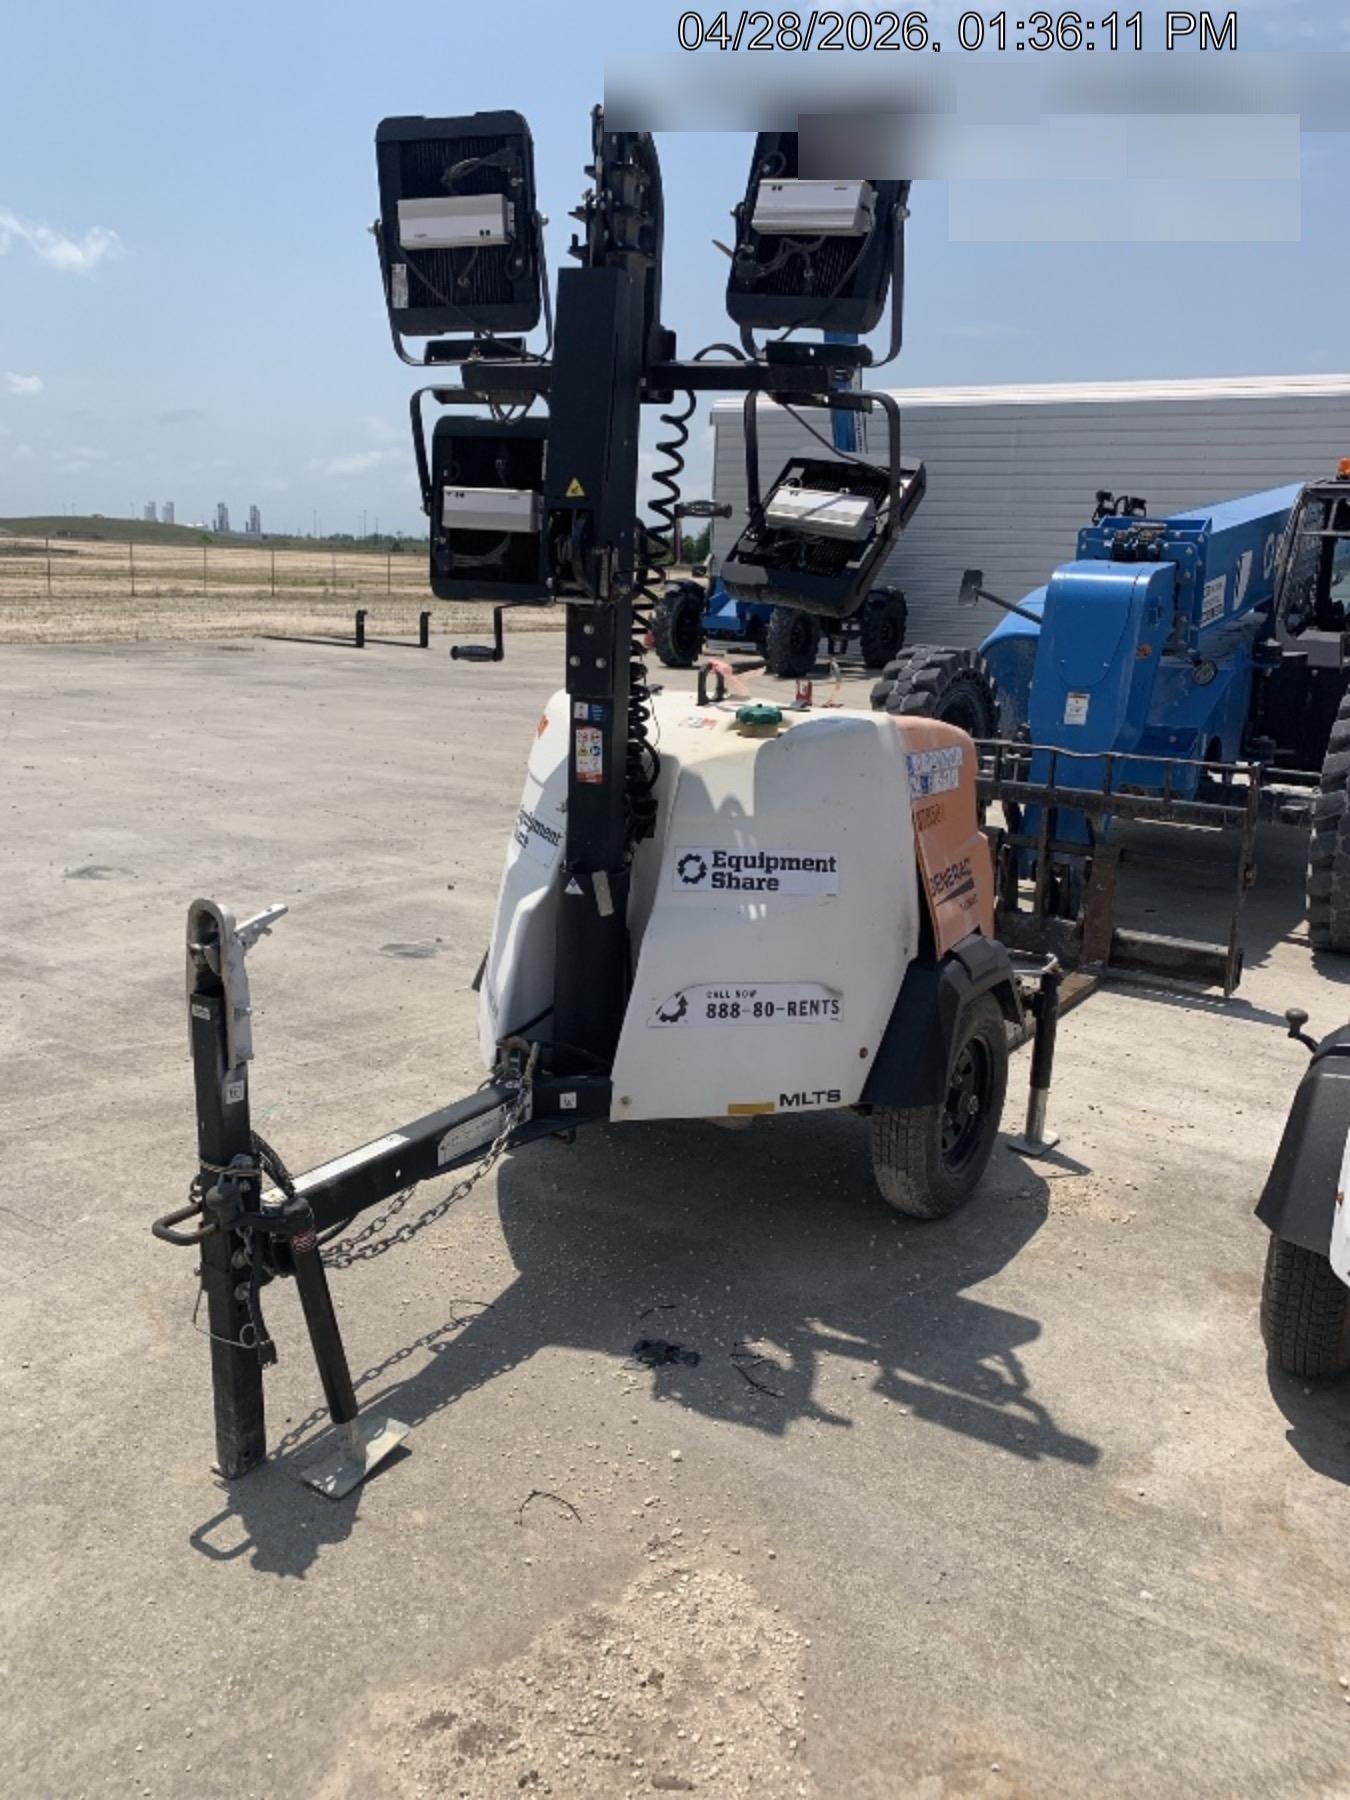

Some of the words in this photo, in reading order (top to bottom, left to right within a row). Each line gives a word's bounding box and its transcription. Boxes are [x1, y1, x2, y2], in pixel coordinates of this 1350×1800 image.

[712, 851, 837, 875] Equipment
[711, 872, 780, 892] Share
[705, 989, 731, 999] CALL
[705, 999, 841, 1019] 888-80-RENTS
[779, 1089, 841, 1107] MLTS
